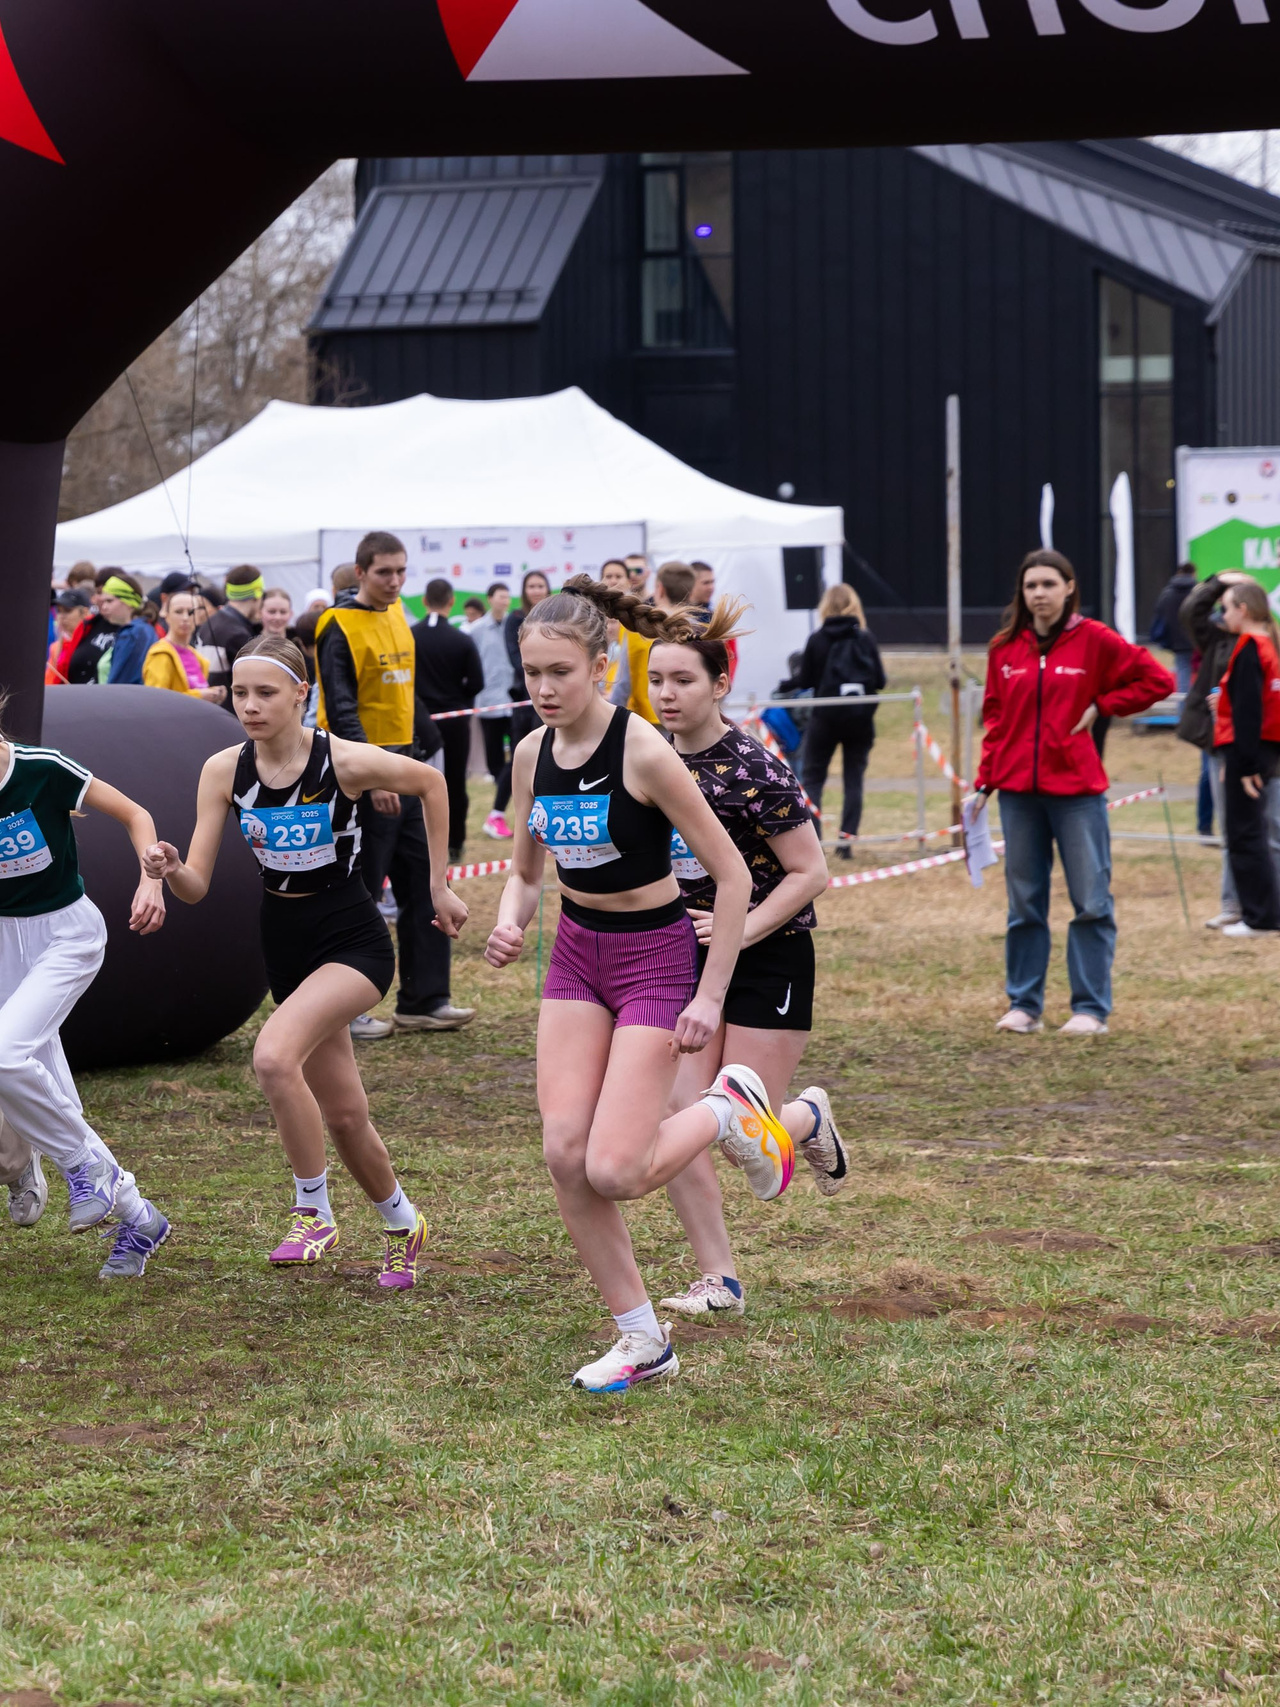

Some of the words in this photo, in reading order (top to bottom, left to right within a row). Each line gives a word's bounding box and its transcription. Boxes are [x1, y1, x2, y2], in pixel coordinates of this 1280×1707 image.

[579, 801, 598, 809] 2025
[301, 810, 320, 818] 2025
[7, 818, 25, 830] 2025
[551, 815, 599, 841] 235
[273, 823, 321, 848] 237
